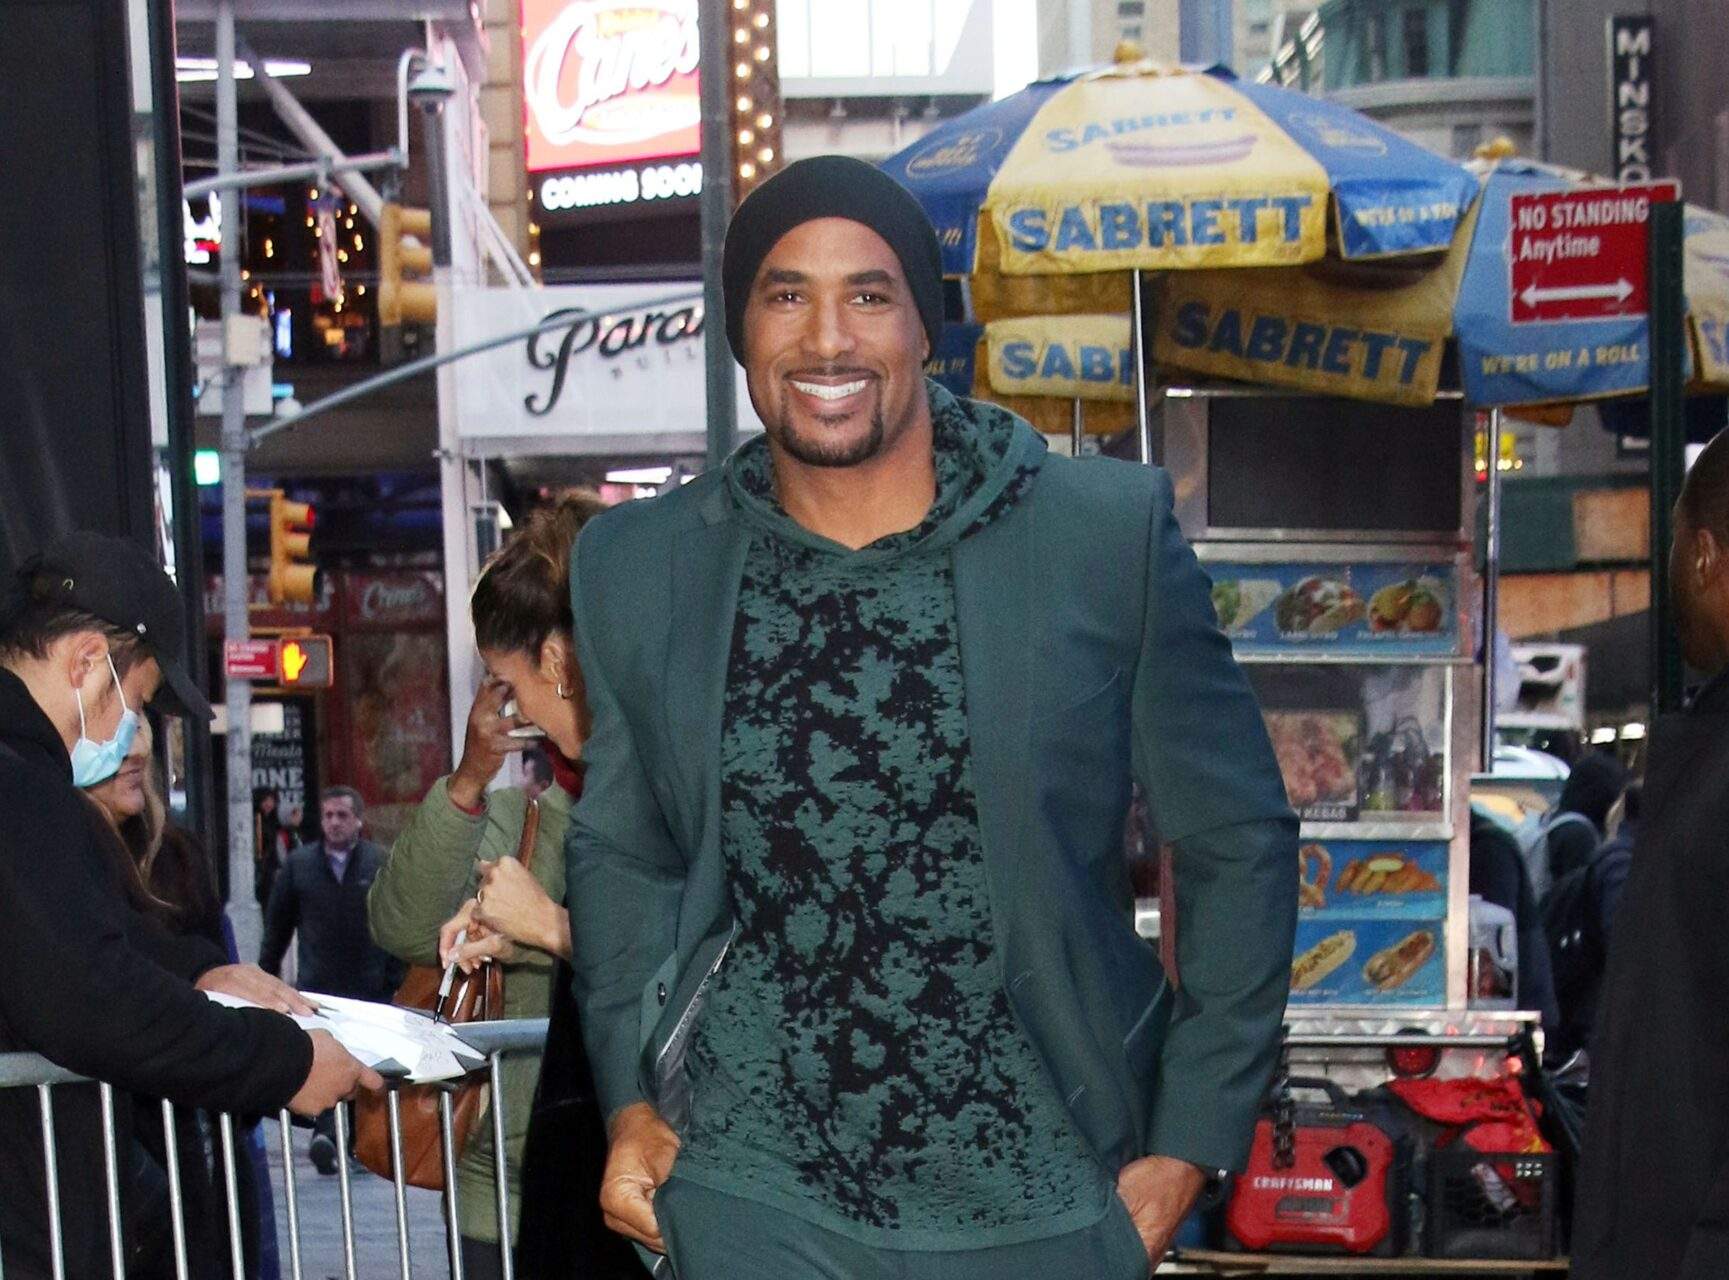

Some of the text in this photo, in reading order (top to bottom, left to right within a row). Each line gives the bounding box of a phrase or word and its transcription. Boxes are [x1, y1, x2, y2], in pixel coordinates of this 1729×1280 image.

[1046, 106, 1238, 153] SABRETT
[541, 169, 639, 211] COMING
[1009, 195, 1312, 253] SABRETT
[1518, 196, 1650, 231] NO STANDING
[1520, 232, 1600, 265] Anytime
[1170, 300, 1431, 385] SABRETT
[1545, 350, 1572, 371] ON
[1577, 347, 1590, 368] A
[1595, 344, 1640, 366] ROLL
[252, 767, 304, 789] ONE
[1253, 1176, 1334, 1191] CRAFTSMAN
